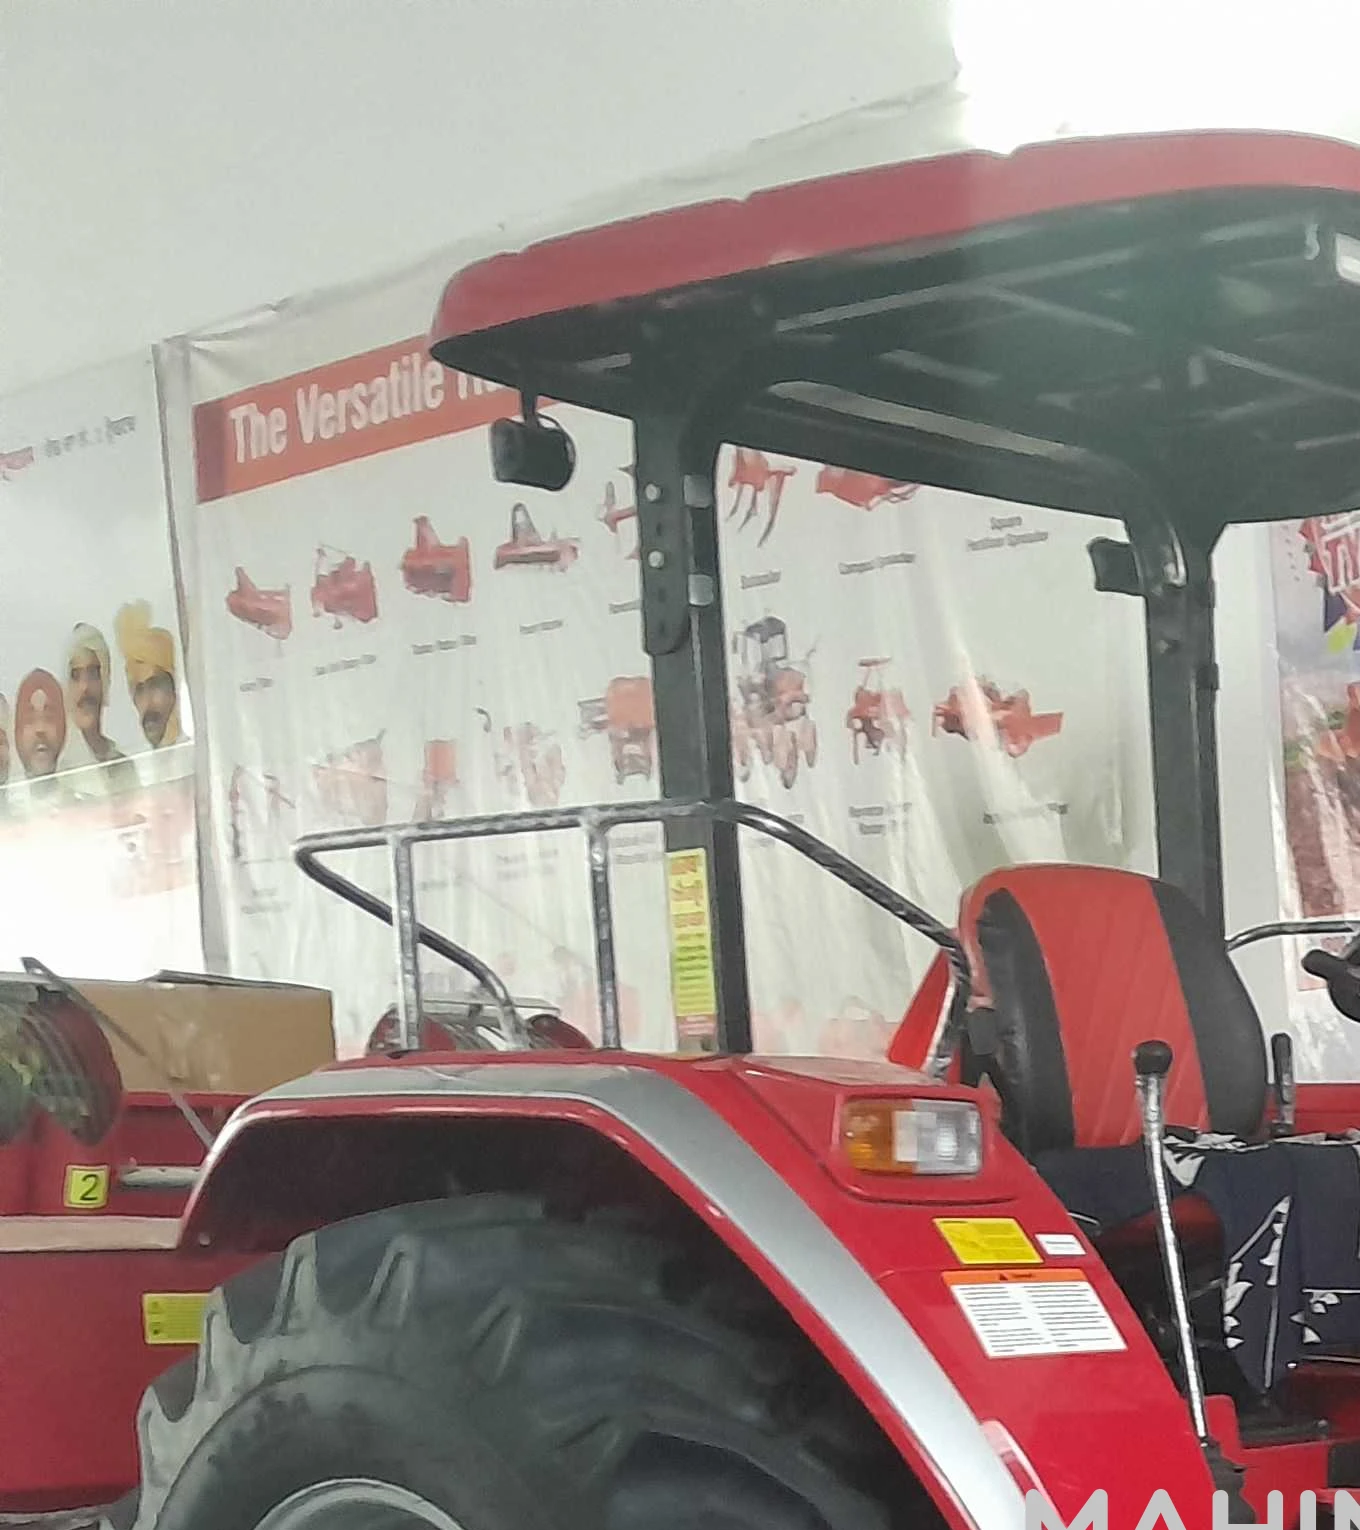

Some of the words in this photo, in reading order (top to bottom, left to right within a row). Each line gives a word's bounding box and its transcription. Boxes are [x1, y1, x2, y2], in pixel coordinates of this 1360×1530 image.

[227, 403, 288, 464] The
[296, 352, 446, 445] Versatile
[79, 1173, 100, 1202] 2
